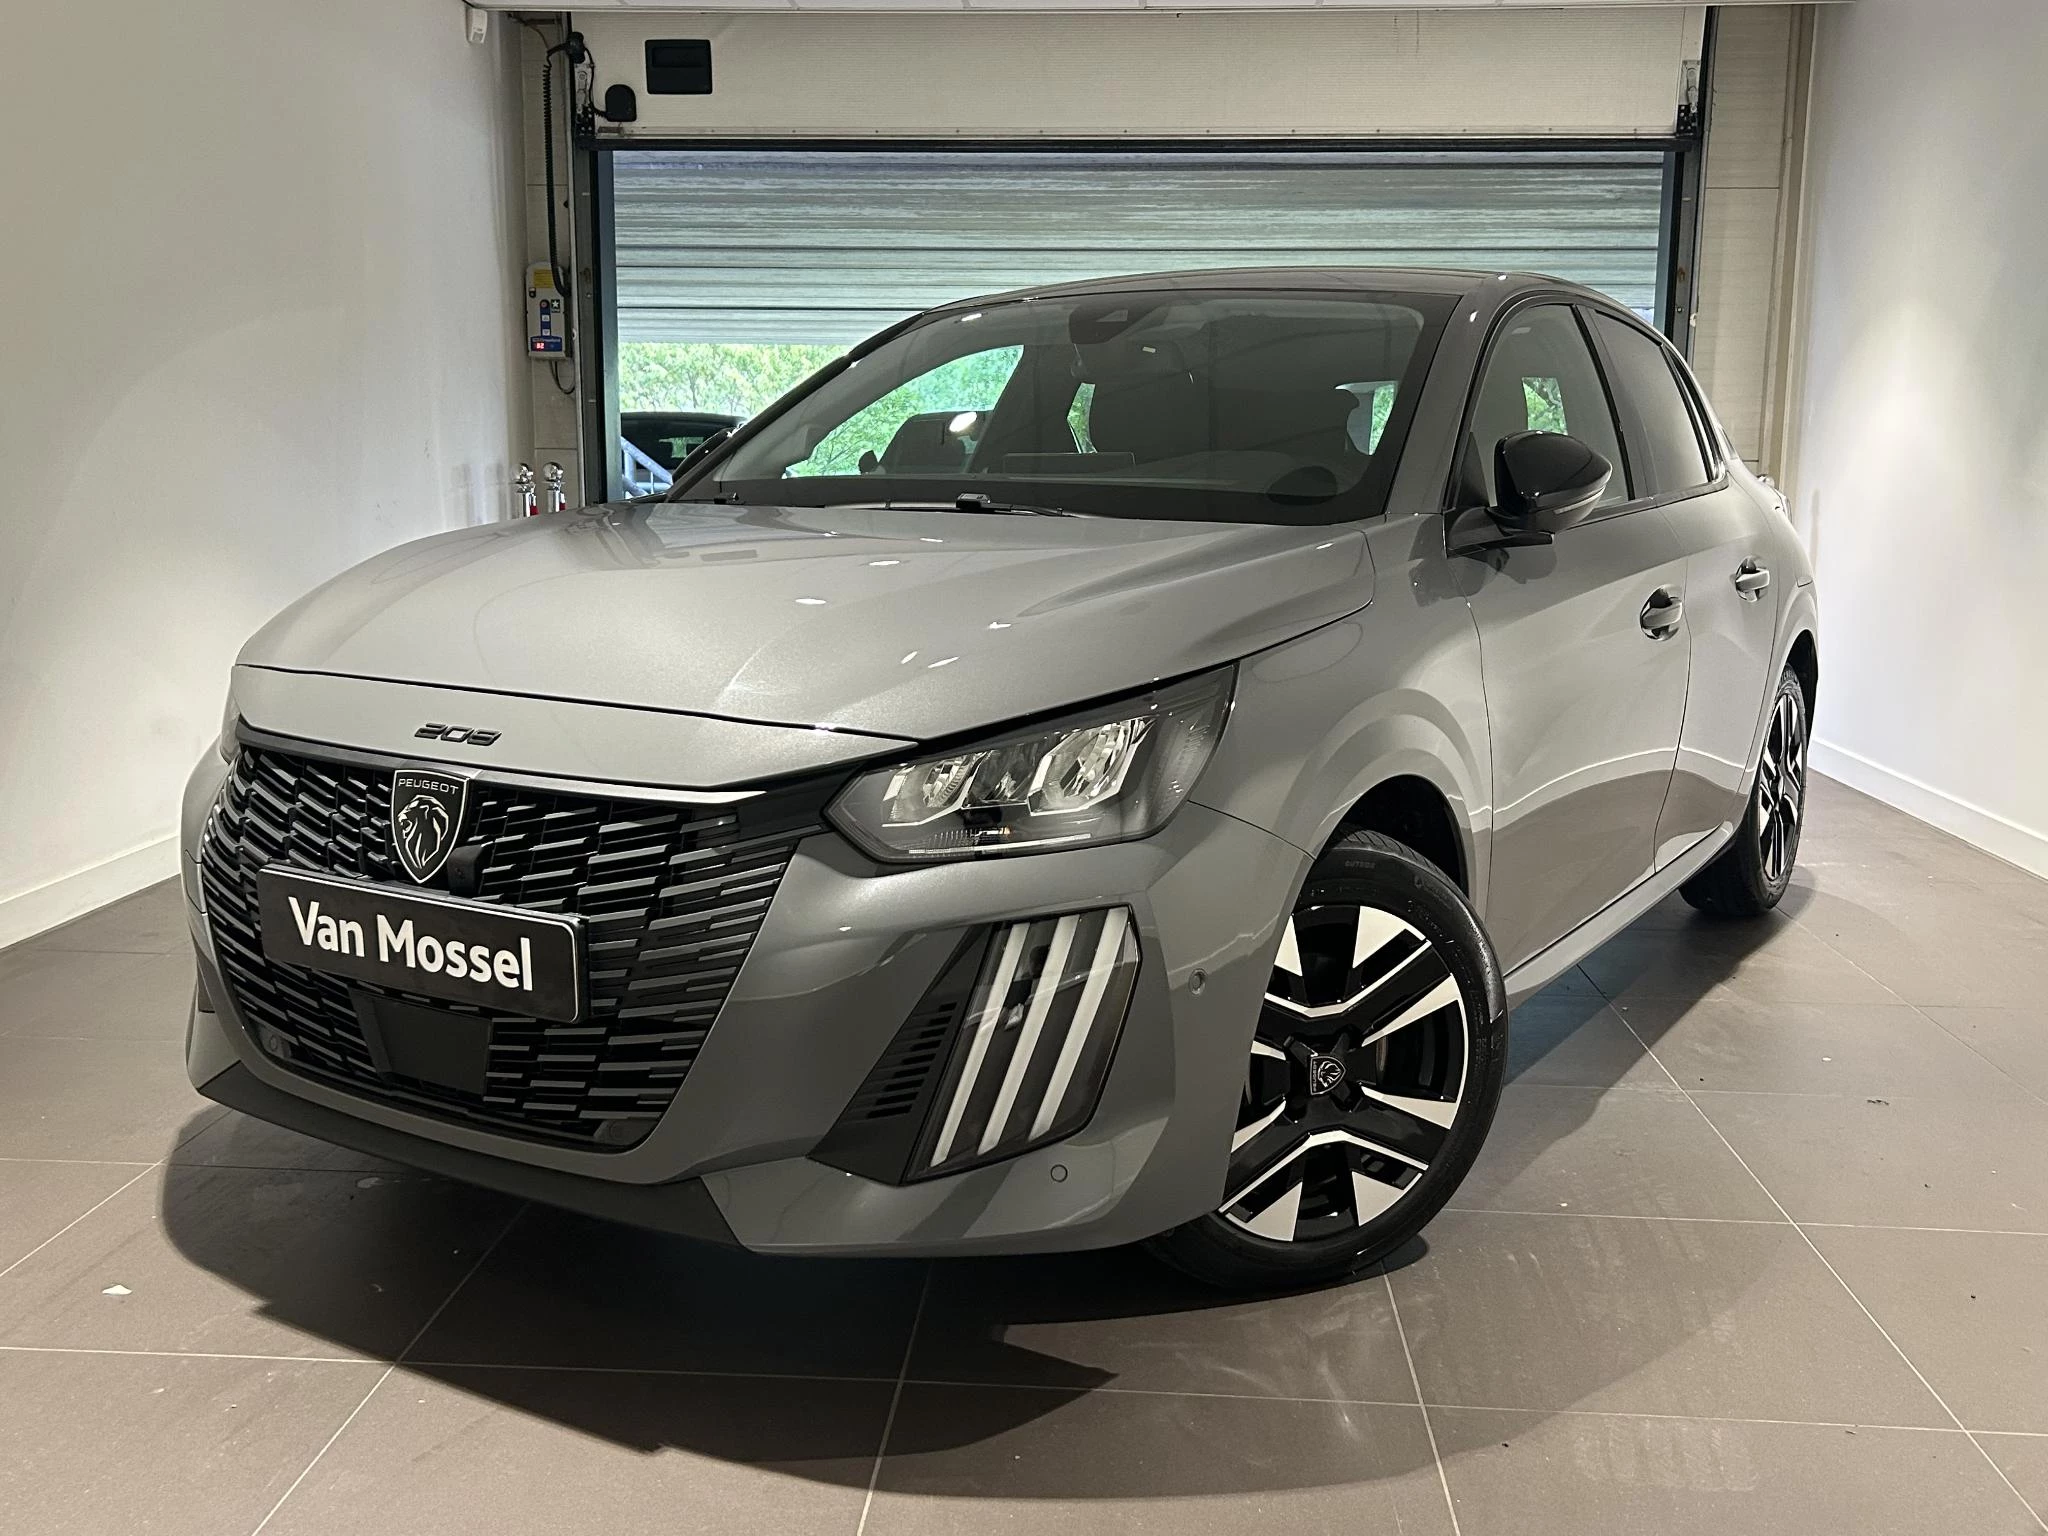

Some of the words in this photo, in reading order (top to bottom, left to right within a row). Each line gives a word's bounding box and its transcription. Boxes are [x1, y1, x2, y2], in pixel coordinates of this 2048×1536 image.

[414, 722, 502, 747] 208
[398, 778, 459, 795] PEUGEOT
[288, 896, 364, 958] Van
[376, 914, 533, 991] Mossel
